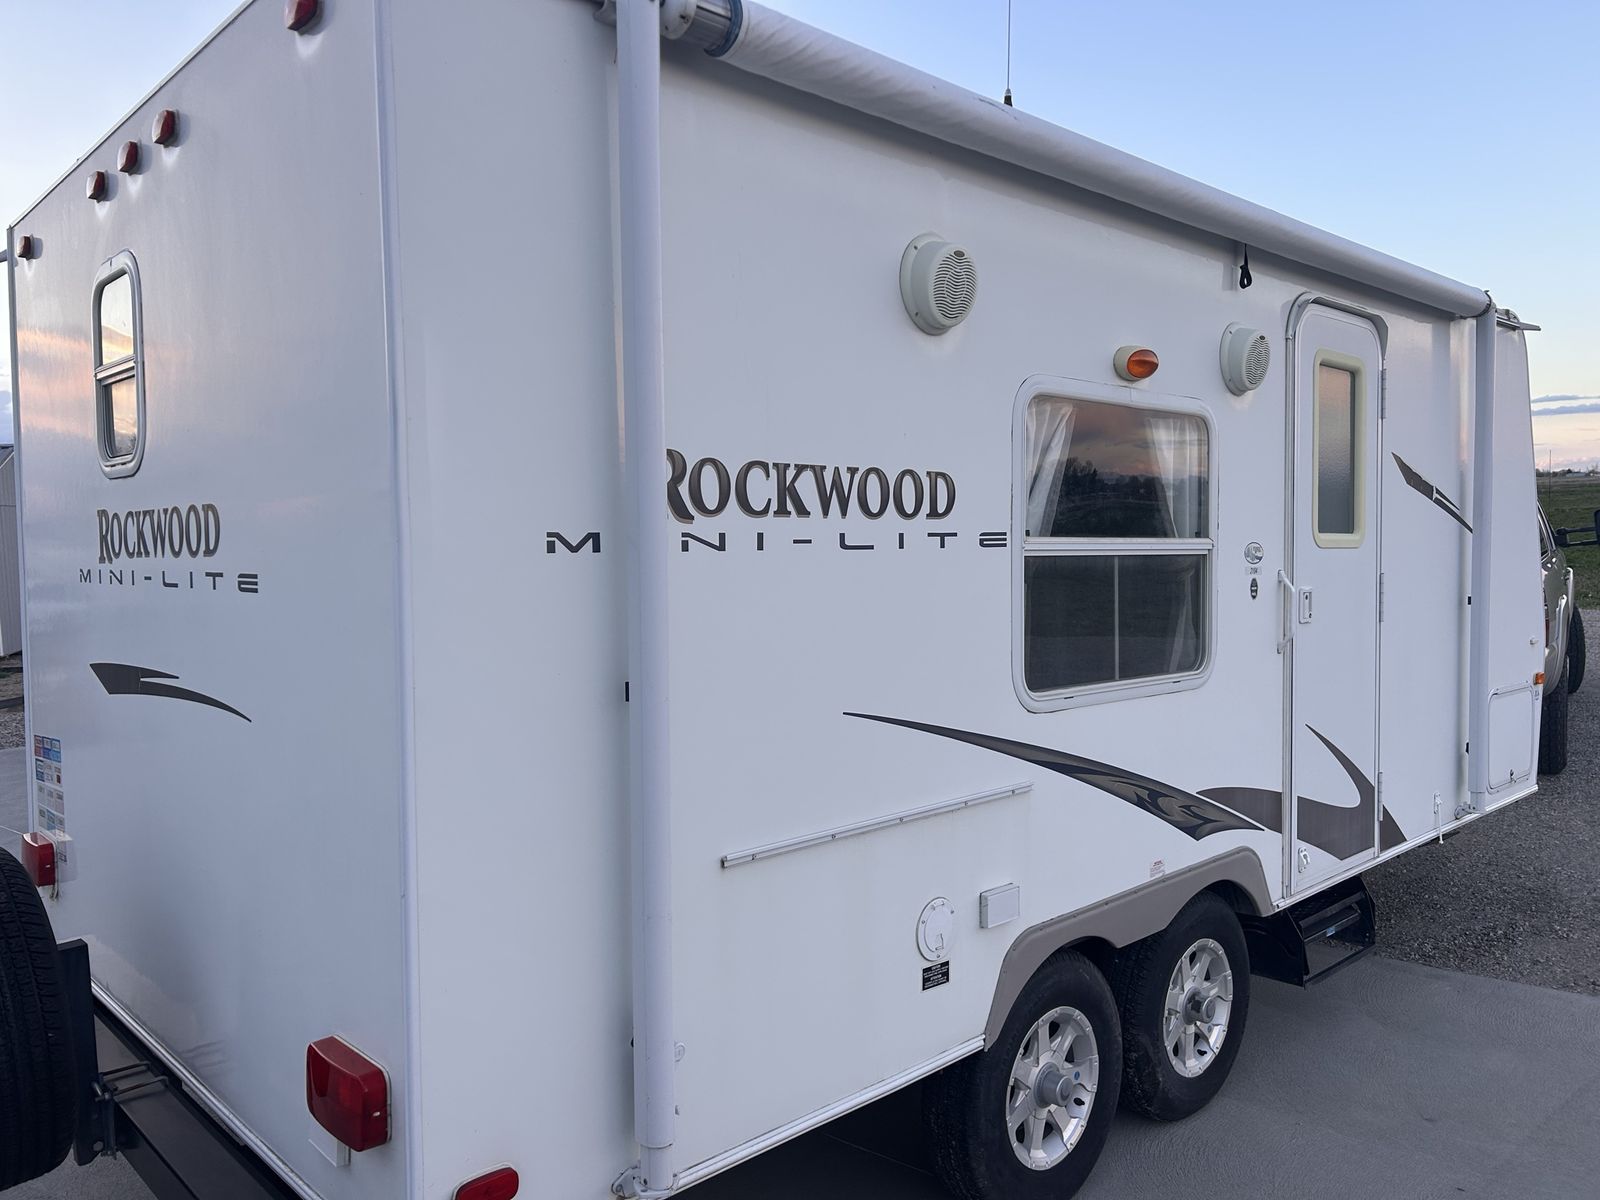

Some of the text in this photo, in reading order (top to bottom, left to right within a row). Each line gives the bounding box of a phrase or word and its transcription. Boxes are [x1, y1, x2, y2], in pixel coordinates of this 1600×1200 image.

[97, 503, 221, 564] ROCKWOOD
[546, 531, 1008, 554] MNI-LITE
[79, 568, 259, 593] MINI-LITE
